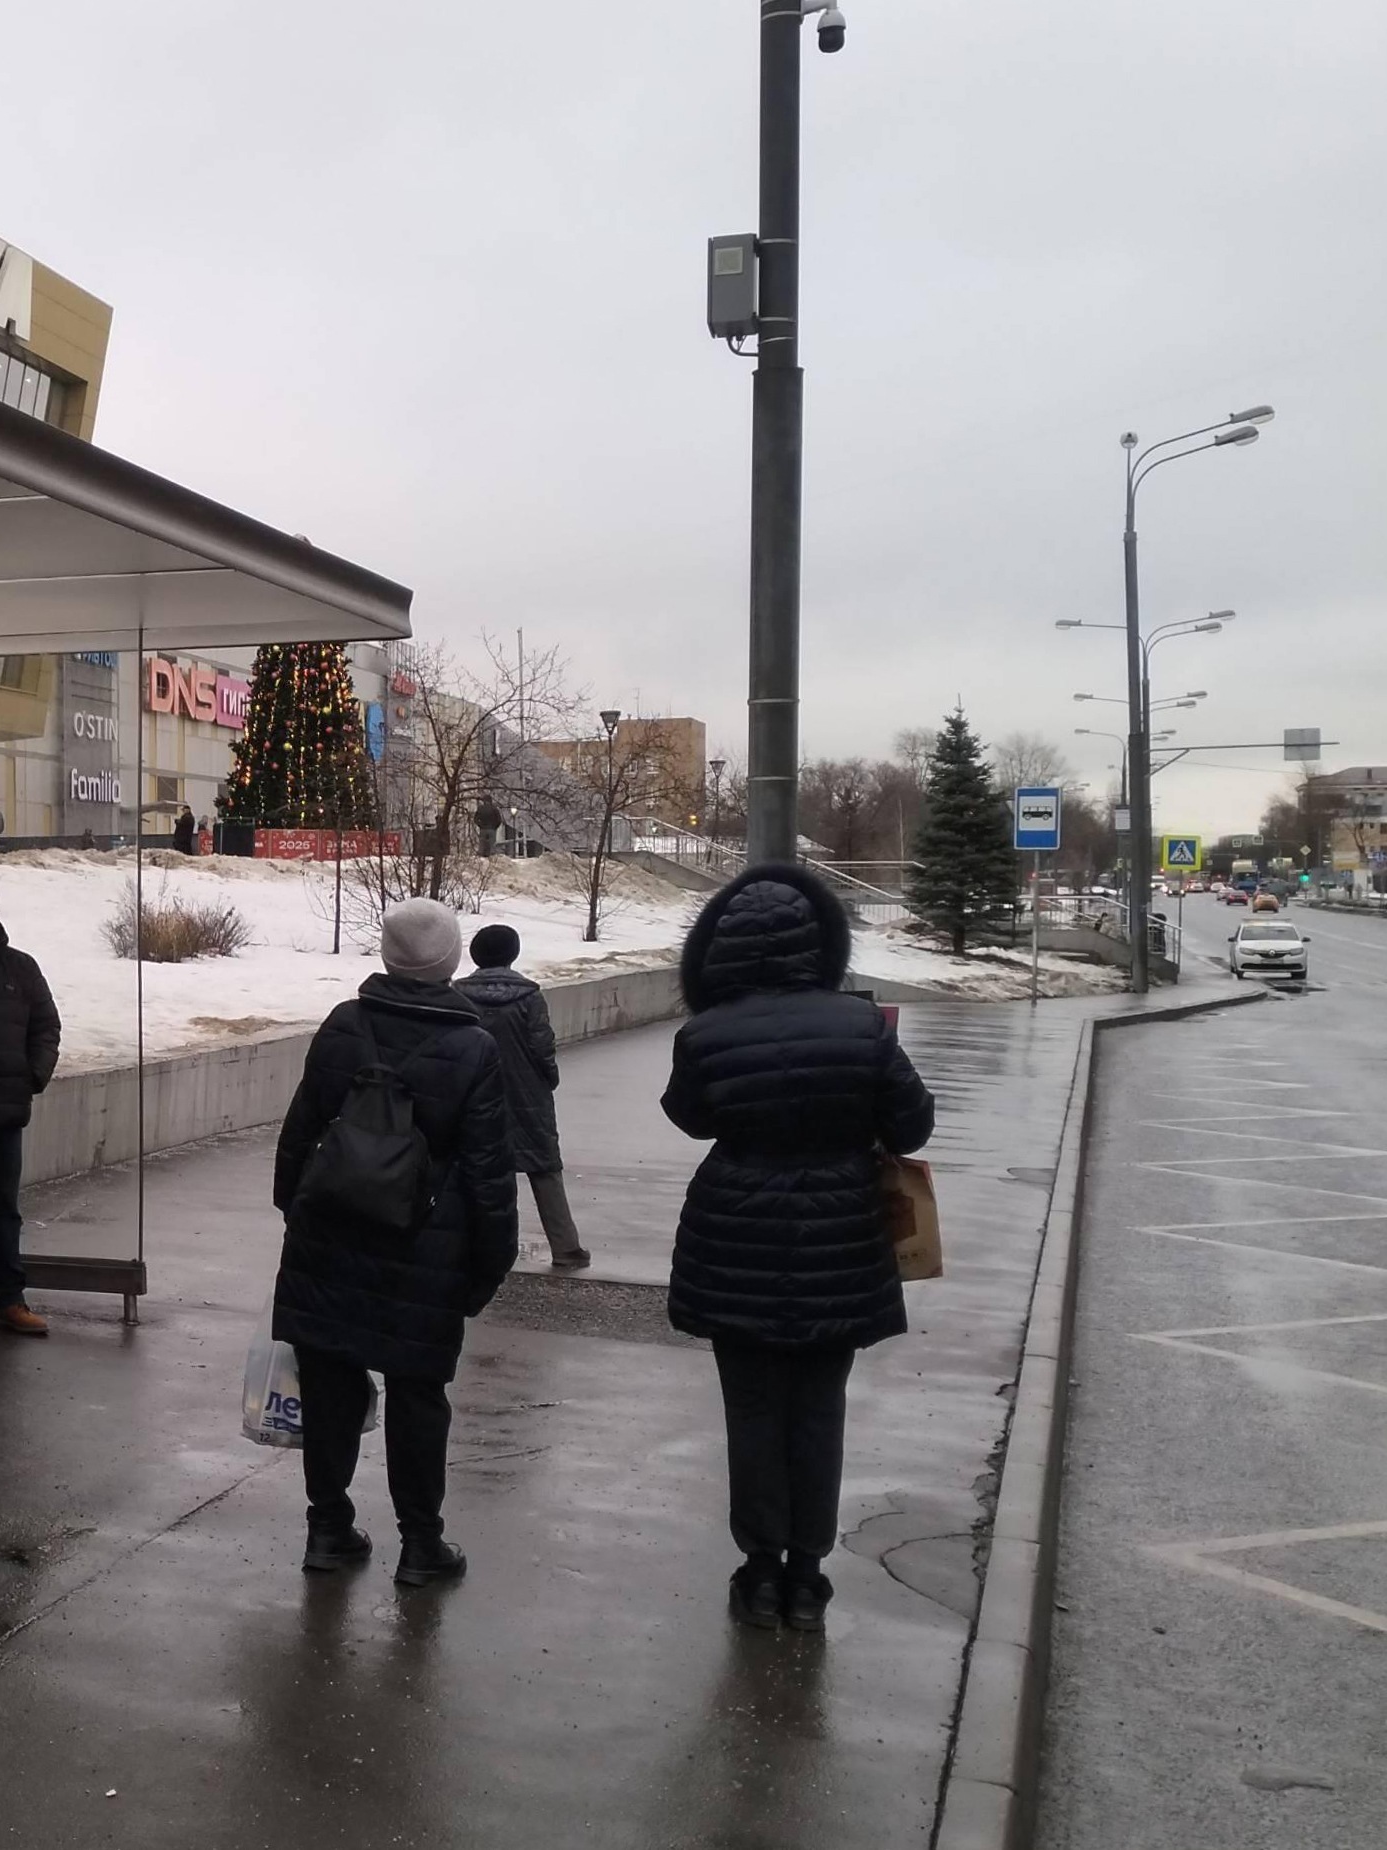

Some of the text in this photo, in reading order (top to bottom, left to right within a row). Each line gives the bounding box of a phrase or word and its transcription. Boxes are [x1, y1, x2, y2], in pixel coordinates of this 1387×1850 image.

[148, 658, 216, 722] DNS
[74, 711, 118, 741] O'STIN
[265, 1391, 302, 1419] ле
